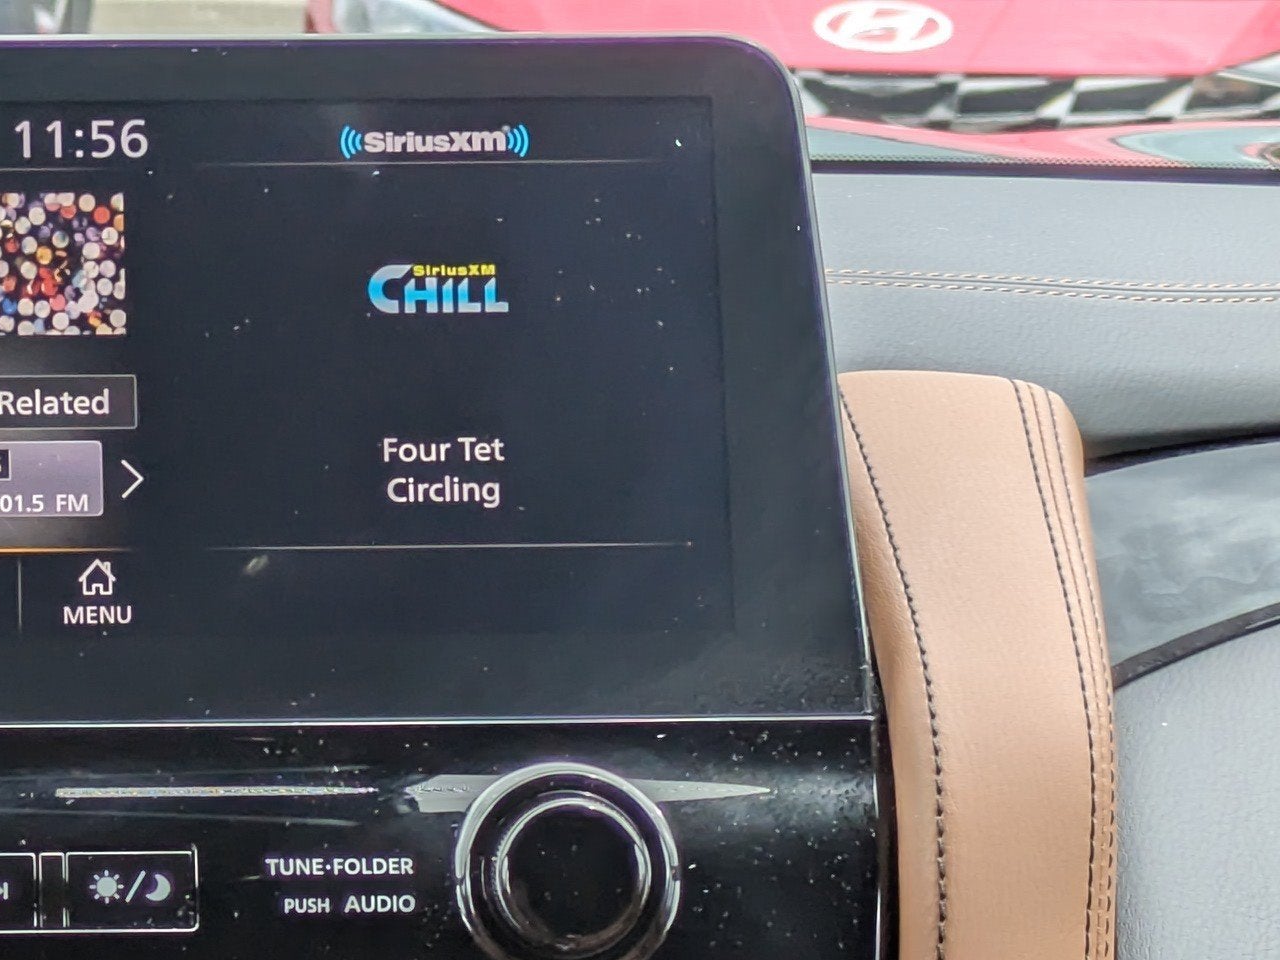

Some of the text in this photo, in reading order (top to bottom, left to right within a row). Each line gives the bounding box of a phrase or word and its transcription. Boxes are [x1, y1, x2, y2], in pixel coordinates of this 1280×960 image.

[14, 119, 149, 159] 11:56
[367, 264, 510, 315] CHILL
[382, 437, 506, 463] Four Tet
[55, 494, 89, 513] FM
[386, 475, 501, 508] Circling
[63, 605, 133, 625] MENU
[284, 895, 416, 914] PUSH AUDIO
